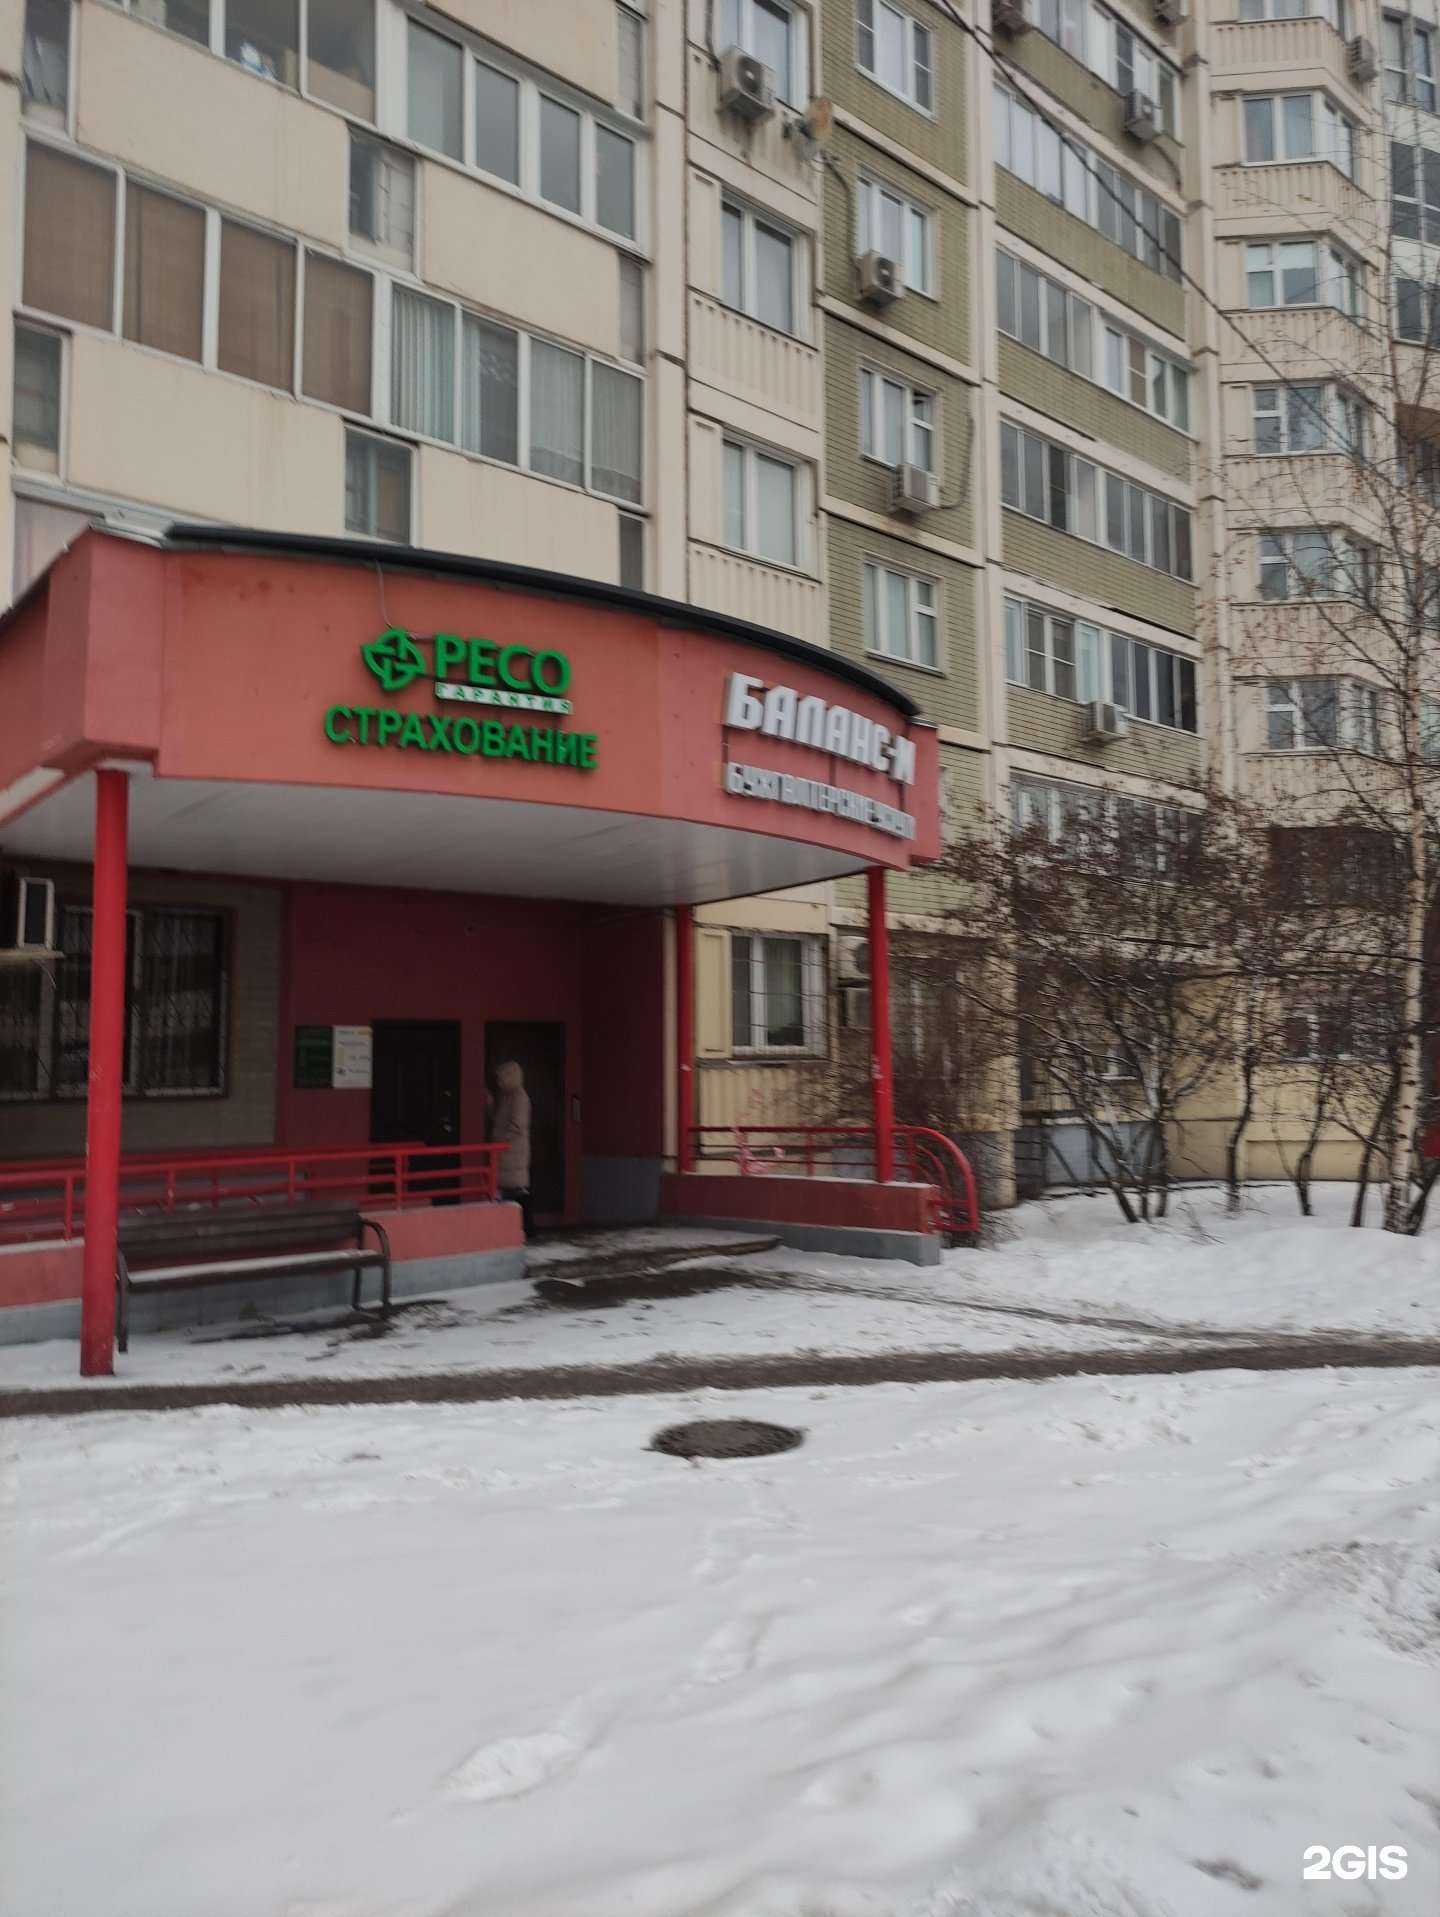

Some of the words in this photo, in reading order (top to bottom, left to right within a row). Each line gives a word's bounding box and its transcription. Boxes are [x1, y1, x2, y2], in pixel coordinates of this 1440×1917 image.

[433, 632, 572, 696] РЕСО
[323, 703, 599, 770] СТРАХОВАНИЕ
[725, 671, 916, 785] БАЛАНС-М
